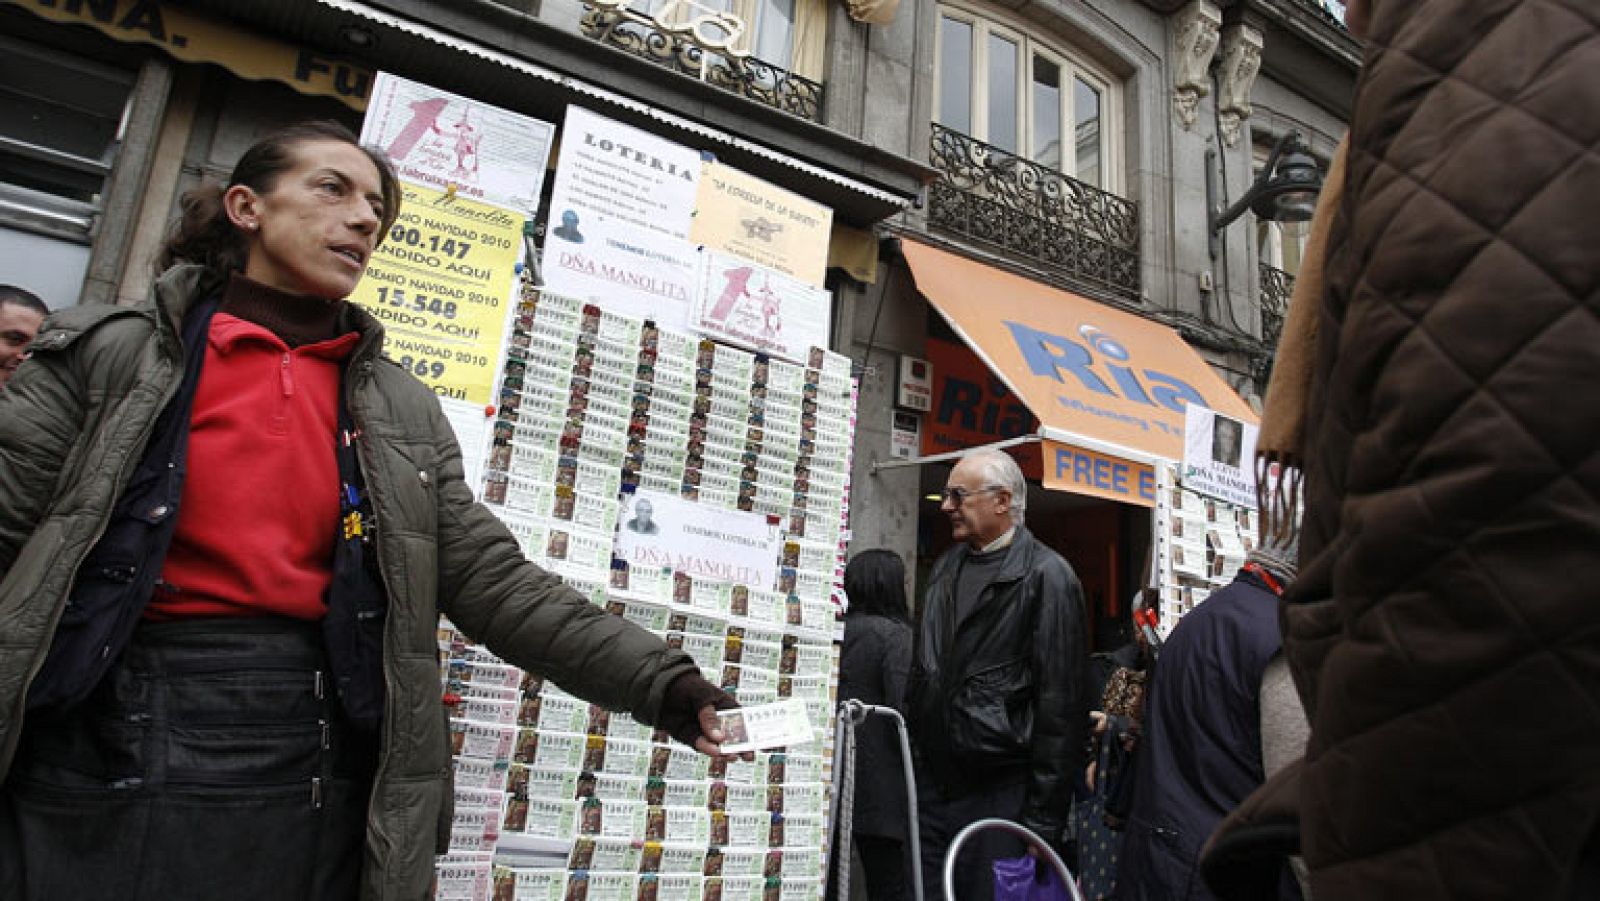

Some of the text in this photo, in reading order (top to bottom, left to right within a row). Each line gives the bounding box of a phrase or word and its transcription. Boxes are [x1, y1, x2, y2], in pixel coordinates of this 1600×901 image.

[584, 131, 693, 182] LOTERIA
[424, 218, 477, 241] NAVIDAD
[480, 233, 511, 249] 2010
[377, 244, 441, 268] NDIDO
[366, 266, 499, 308] REMIO NAVIDAD 2010
[601, 263, 687, 302] MANOLITA
[365, 305, 428, 328] NDIDO
[376, 286, 458, 320] 15.548
[395, 338, 453, 360] NAVIDAD
[455, 351, 488, 368] 2010
[400, 354, 445, 380] 869
[1001, 320, 1210, 414] Ria
[430, 385, 468, 401] QUÍ
[937, 373, 1034, 439] Ria
[1055, 447, 1156, 501] FREE E
[676, 552, 763, 588] MANOLITA
